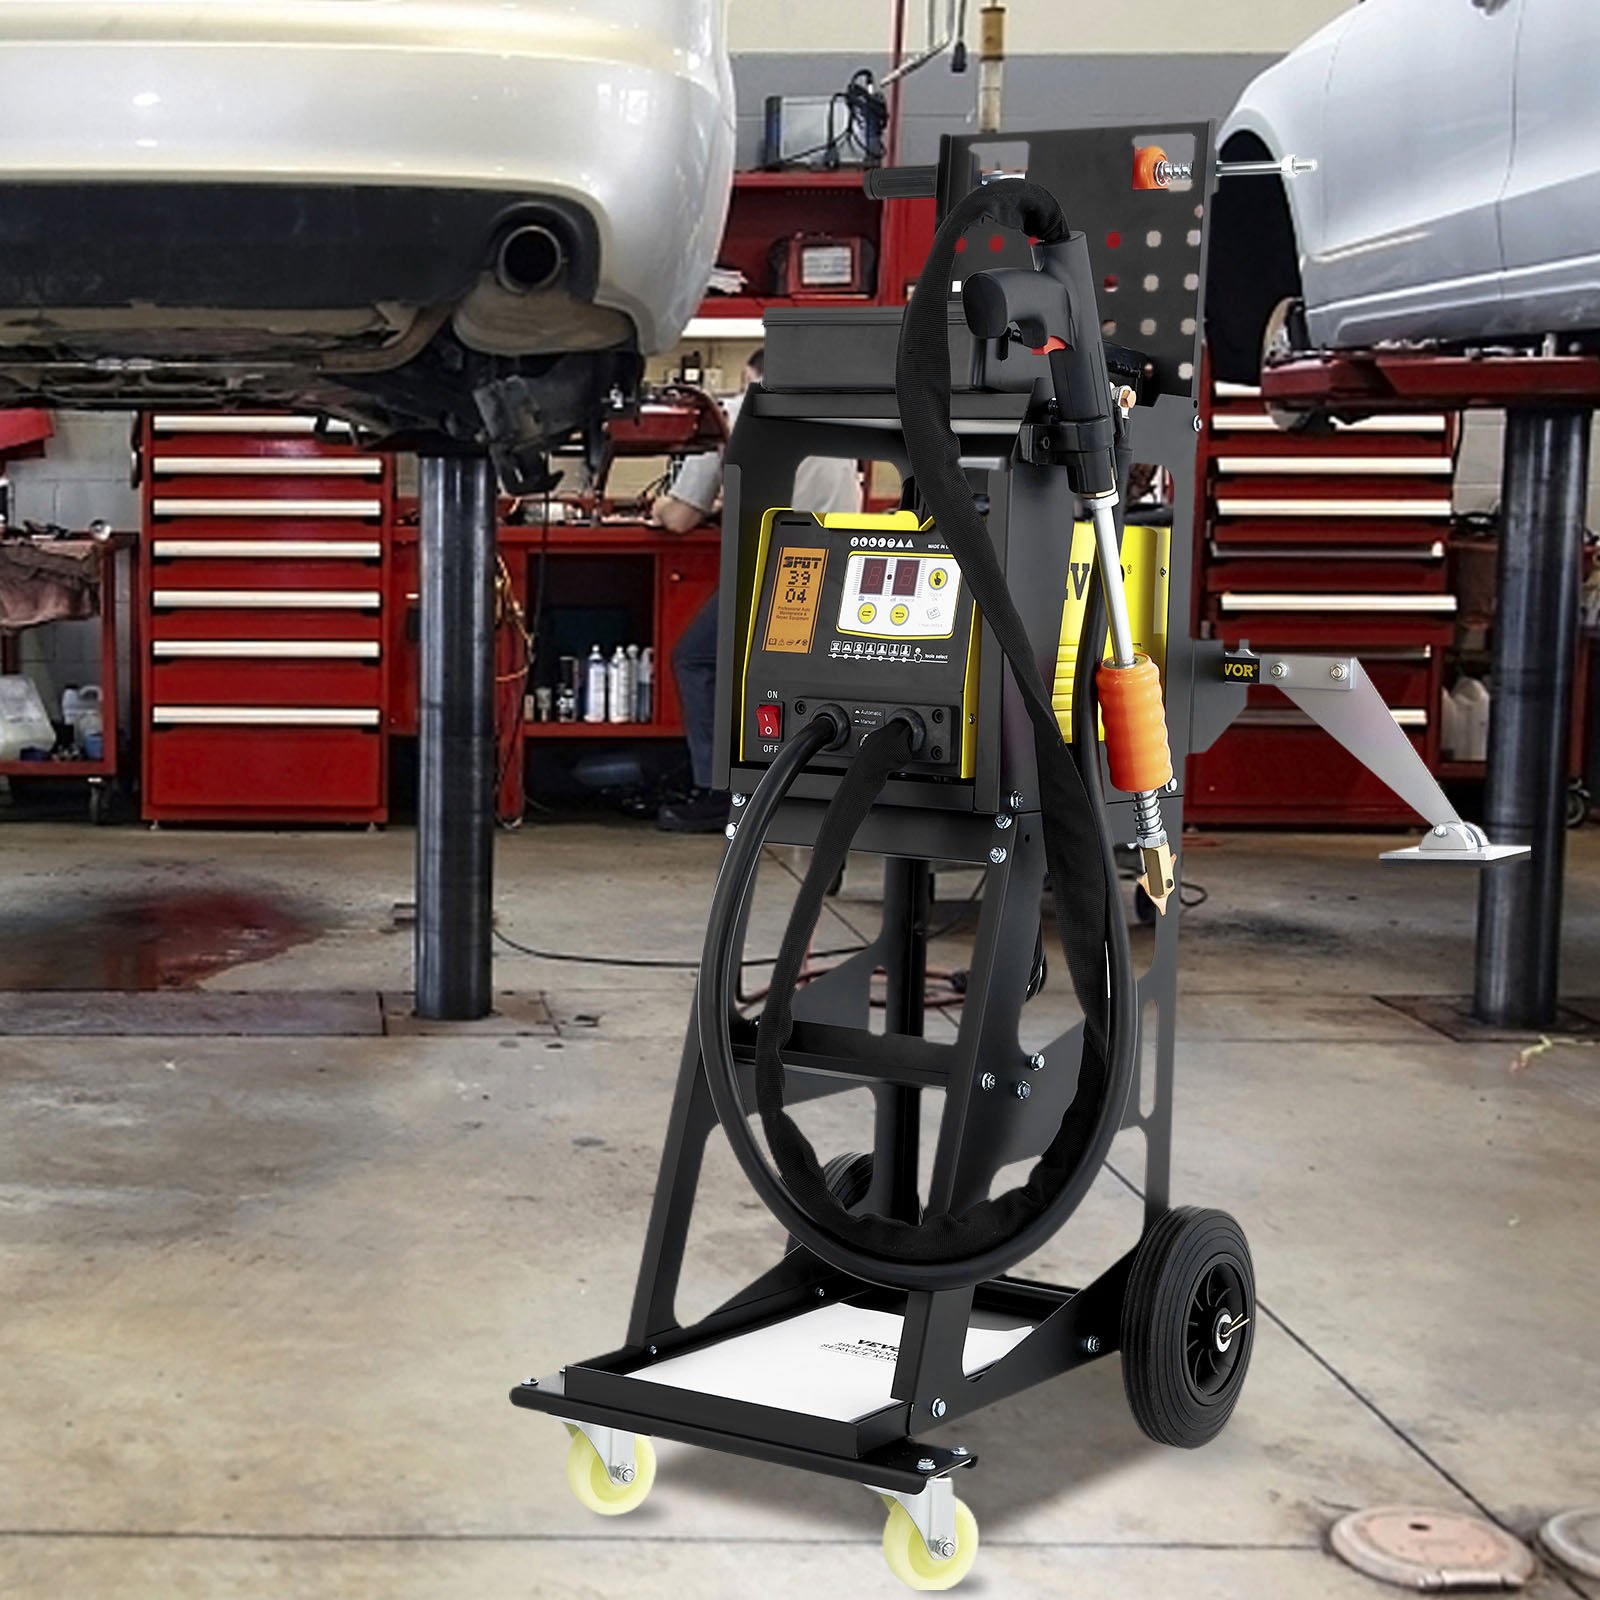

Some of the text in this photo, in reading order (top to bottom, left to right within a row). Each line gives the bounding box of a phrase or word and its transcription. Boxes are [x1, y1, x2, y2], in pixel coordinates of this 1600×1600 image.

[783, 556, 822, 569] SPOT
[787, 570, 811, 586] 39
[785, 588, 807, 604] 04
[767, 690, 778, 699] ON
[861, 709, 882, 717] Automatic
[763, 744, 779, 753] OFF
[858, 1339, 900, 1353] VEVO
